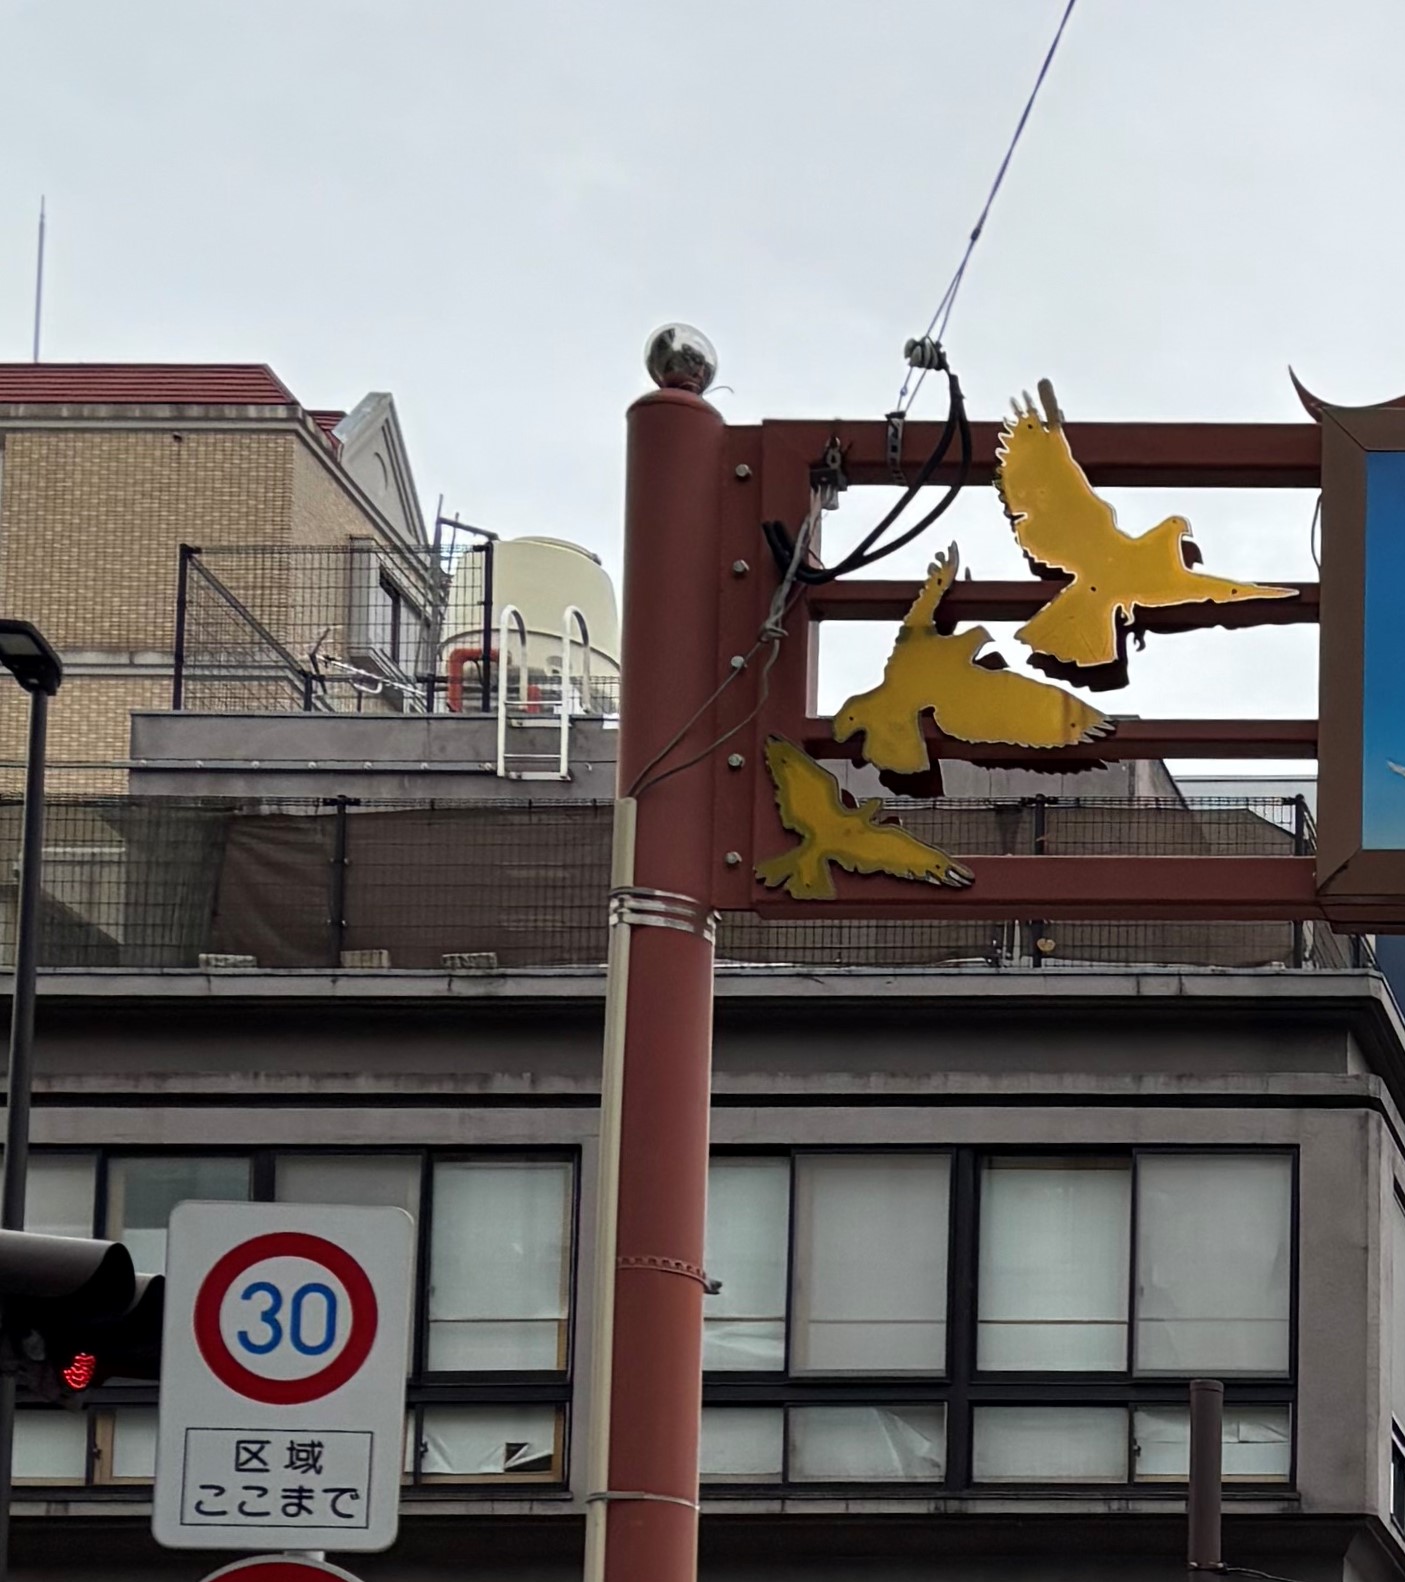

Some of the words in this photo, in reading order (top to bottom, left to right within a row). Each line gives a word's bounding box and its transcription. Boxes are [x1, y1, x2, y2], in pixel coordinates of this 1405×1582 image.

[237, 1281, 337, 1356] 30
[234, 1439, 324, 1475] 区域
[194, 1484, 360, 1519] ここまで
